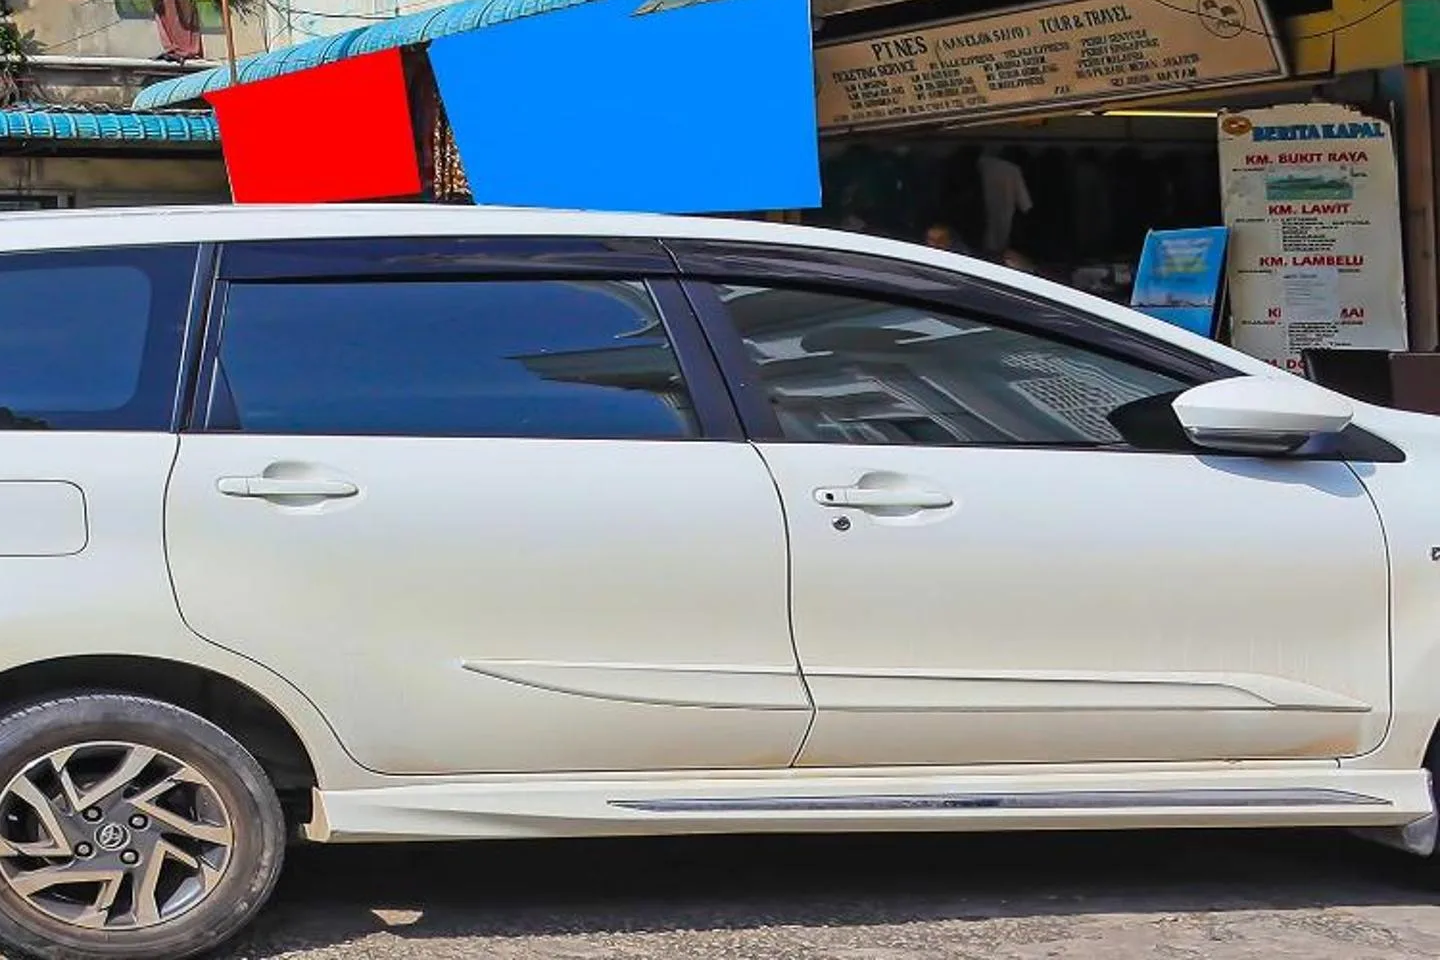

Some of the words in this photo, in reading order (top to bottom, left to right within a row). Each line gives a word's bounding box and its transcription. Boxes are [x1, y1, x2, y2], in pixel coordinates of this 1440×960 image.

[1039, 15, 1073, 34] TOUR
[1084, 4, 1132, 27] TRAVEL
[1253, 124, 1321, 142] BERITA
[1321, 122, 1385, 139] KAPAL
[1328, 150, 1368, 163] RAYA
[1302, 202, 1352, 215] LAWIT
